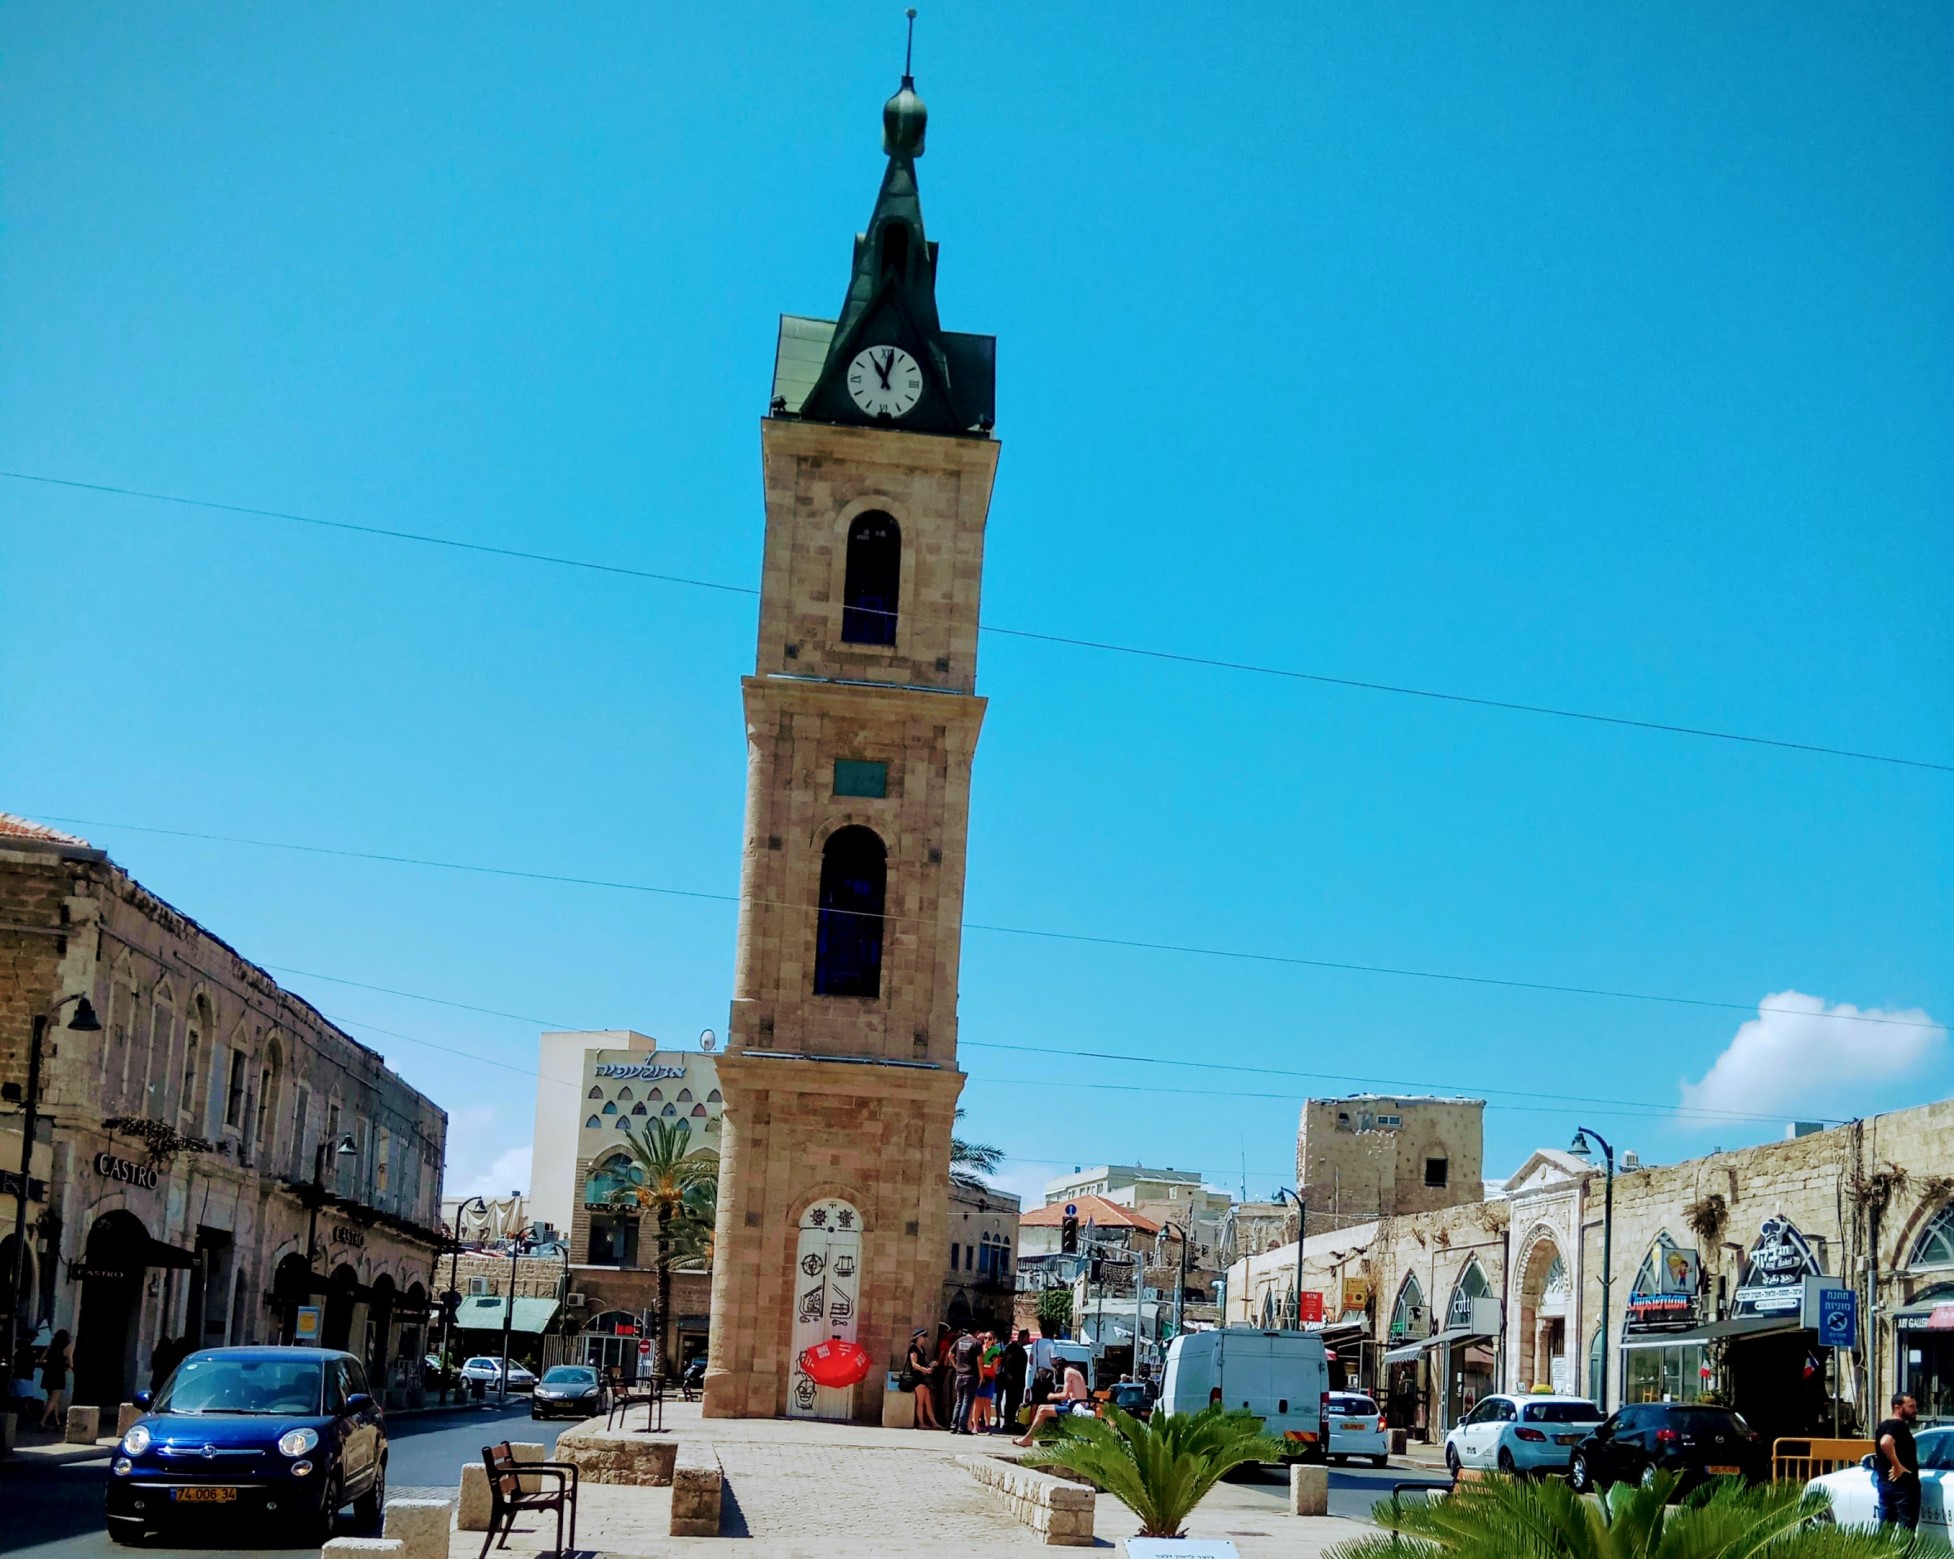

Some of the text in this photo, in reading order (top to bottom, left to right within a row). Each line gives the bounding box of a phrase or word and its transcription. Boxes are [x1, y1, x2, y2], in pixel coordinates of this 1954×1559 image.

[100, 1154, 159, 1189] CASTRO
[336, 1226, 365, 1248] CASTRO
[78, 1269, 124, 1278] CASTRO
[1827, 1291, 1849, 1300] תחנת
[1824, 1301, 1851, 1311] מוניות
[1897, 1318, 1909, 1329] ART
[177, 1488, 192, 1500] 74
[221, 1488, 236, 1500] 34
